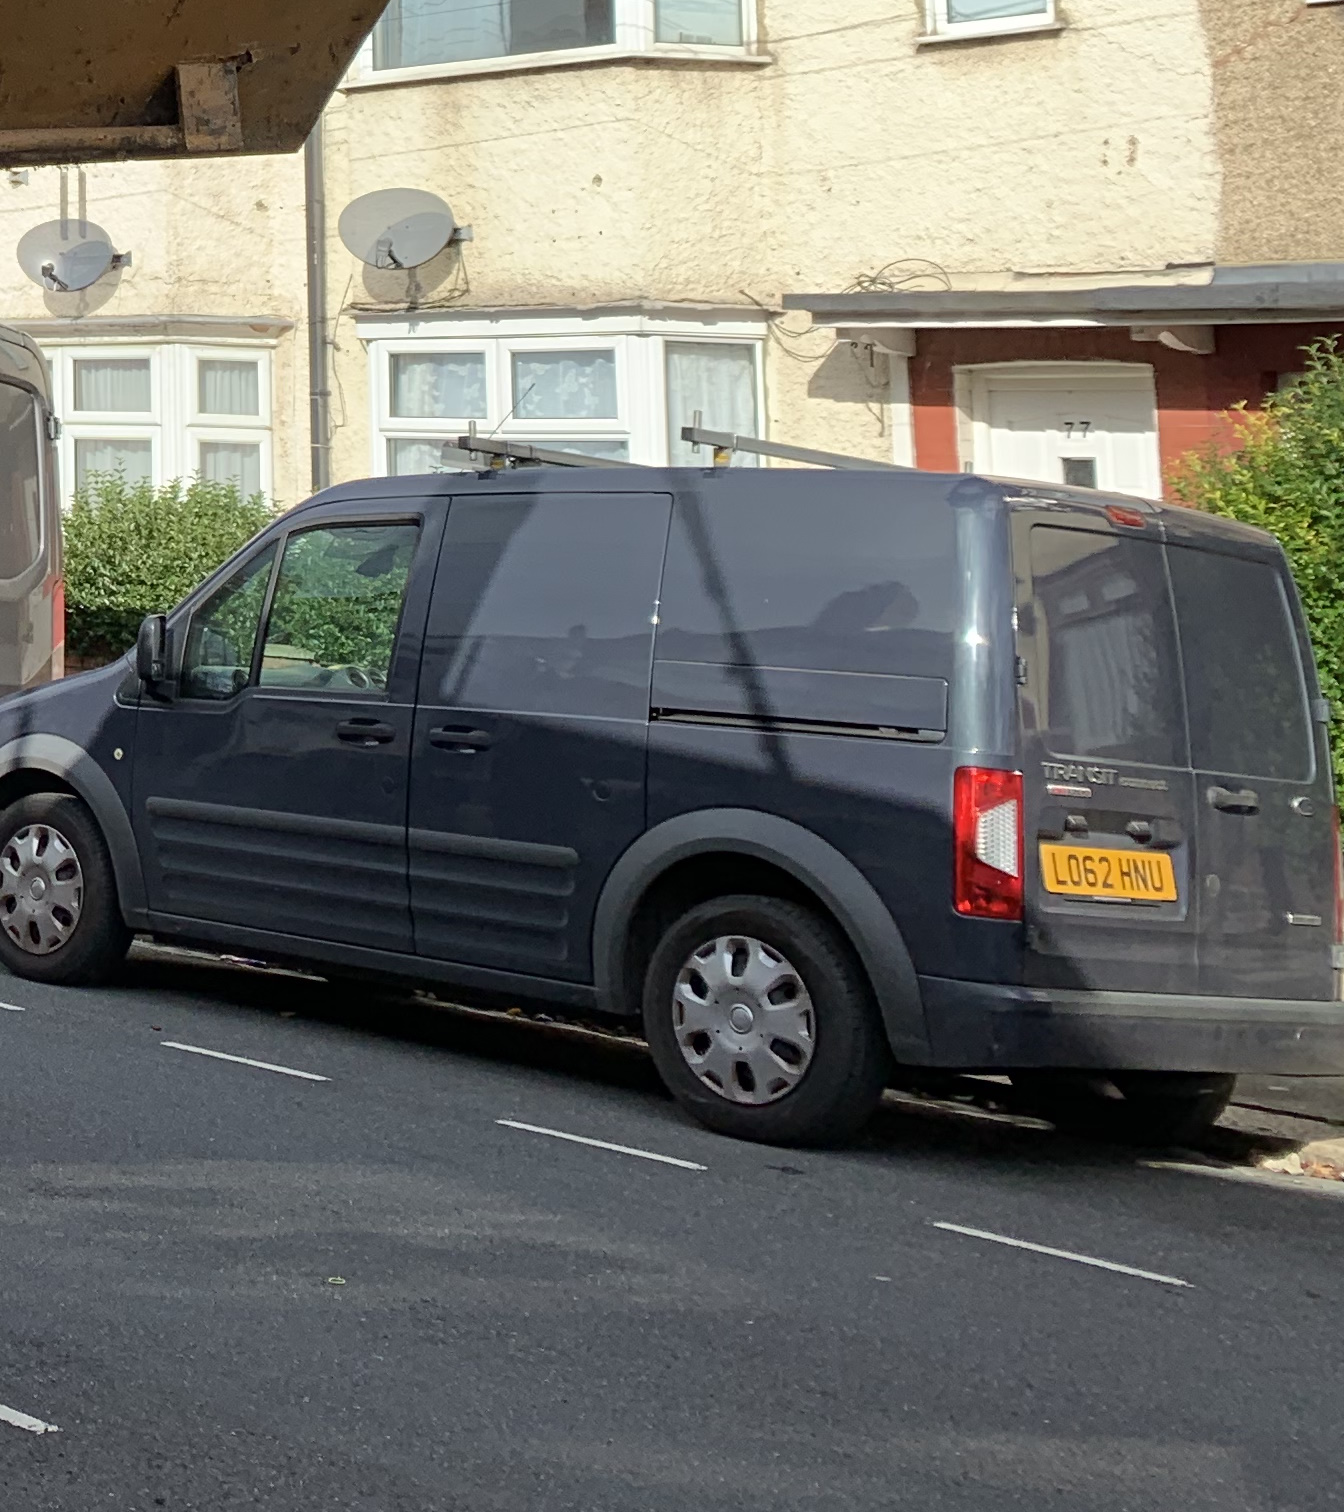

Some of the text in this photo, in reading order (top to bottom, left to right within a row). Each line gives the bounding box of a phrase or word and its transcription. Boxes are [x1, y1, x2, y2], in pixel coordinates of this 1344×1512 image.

[1064, 421, 1091, 439] 77
[1041, 761, 1119, 785] TRANSIT
[1051, 852, 1164, 893] LO62 HNU
